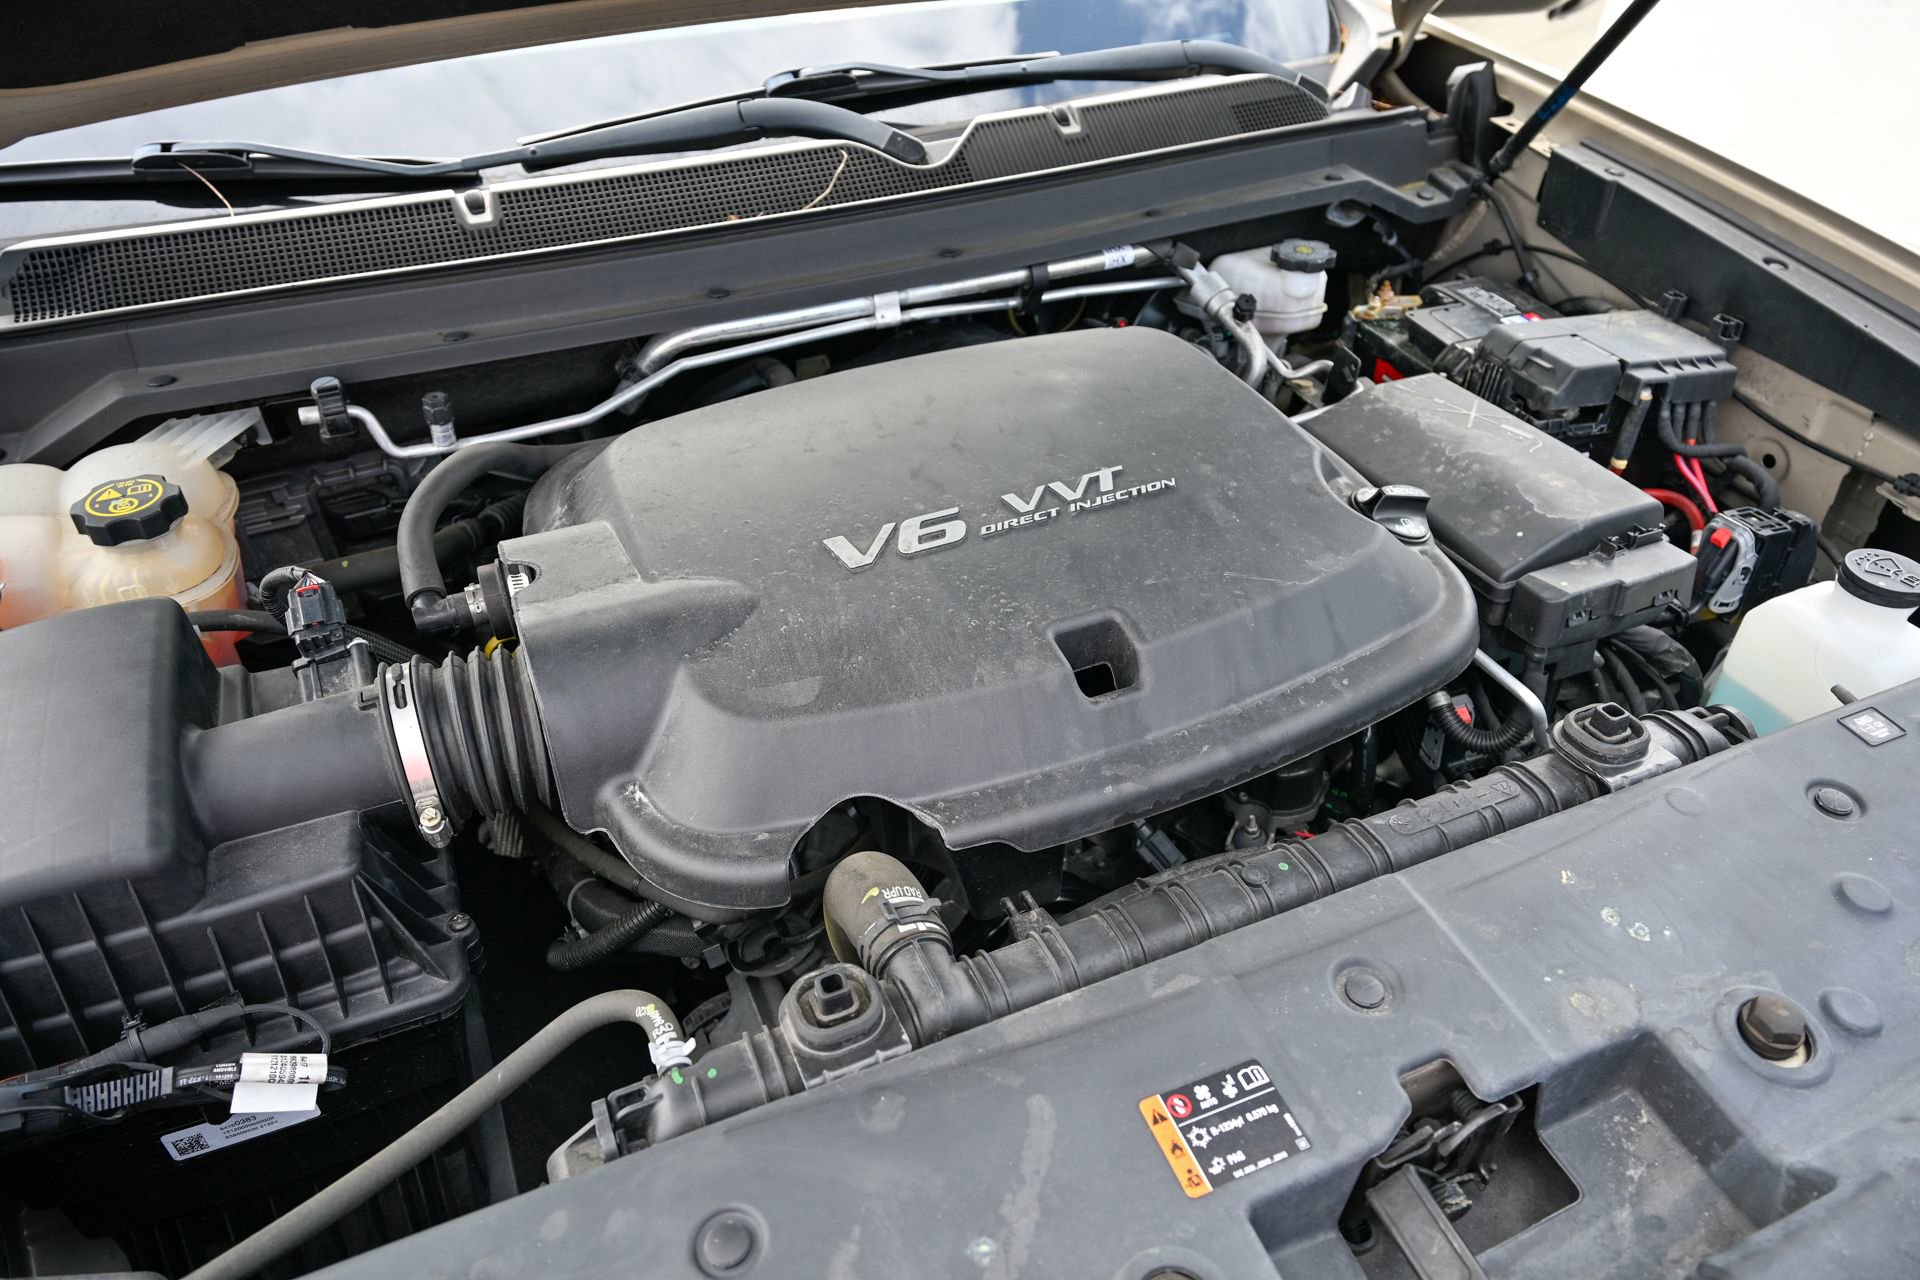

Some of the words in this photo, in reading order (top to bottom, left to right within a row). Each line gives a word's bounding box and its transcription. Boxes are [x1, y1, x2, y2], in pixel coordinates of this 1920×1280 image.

[980, 507, 1061, 537] DIRECT
[1069, 477, 1176, 513] INJECTION
[1000, 464, 1123, 514] VVT
[822, 506, 967, 570] V6
[881, 886, 903, 899] UPR
[903, 886, 922, 899] RAD
